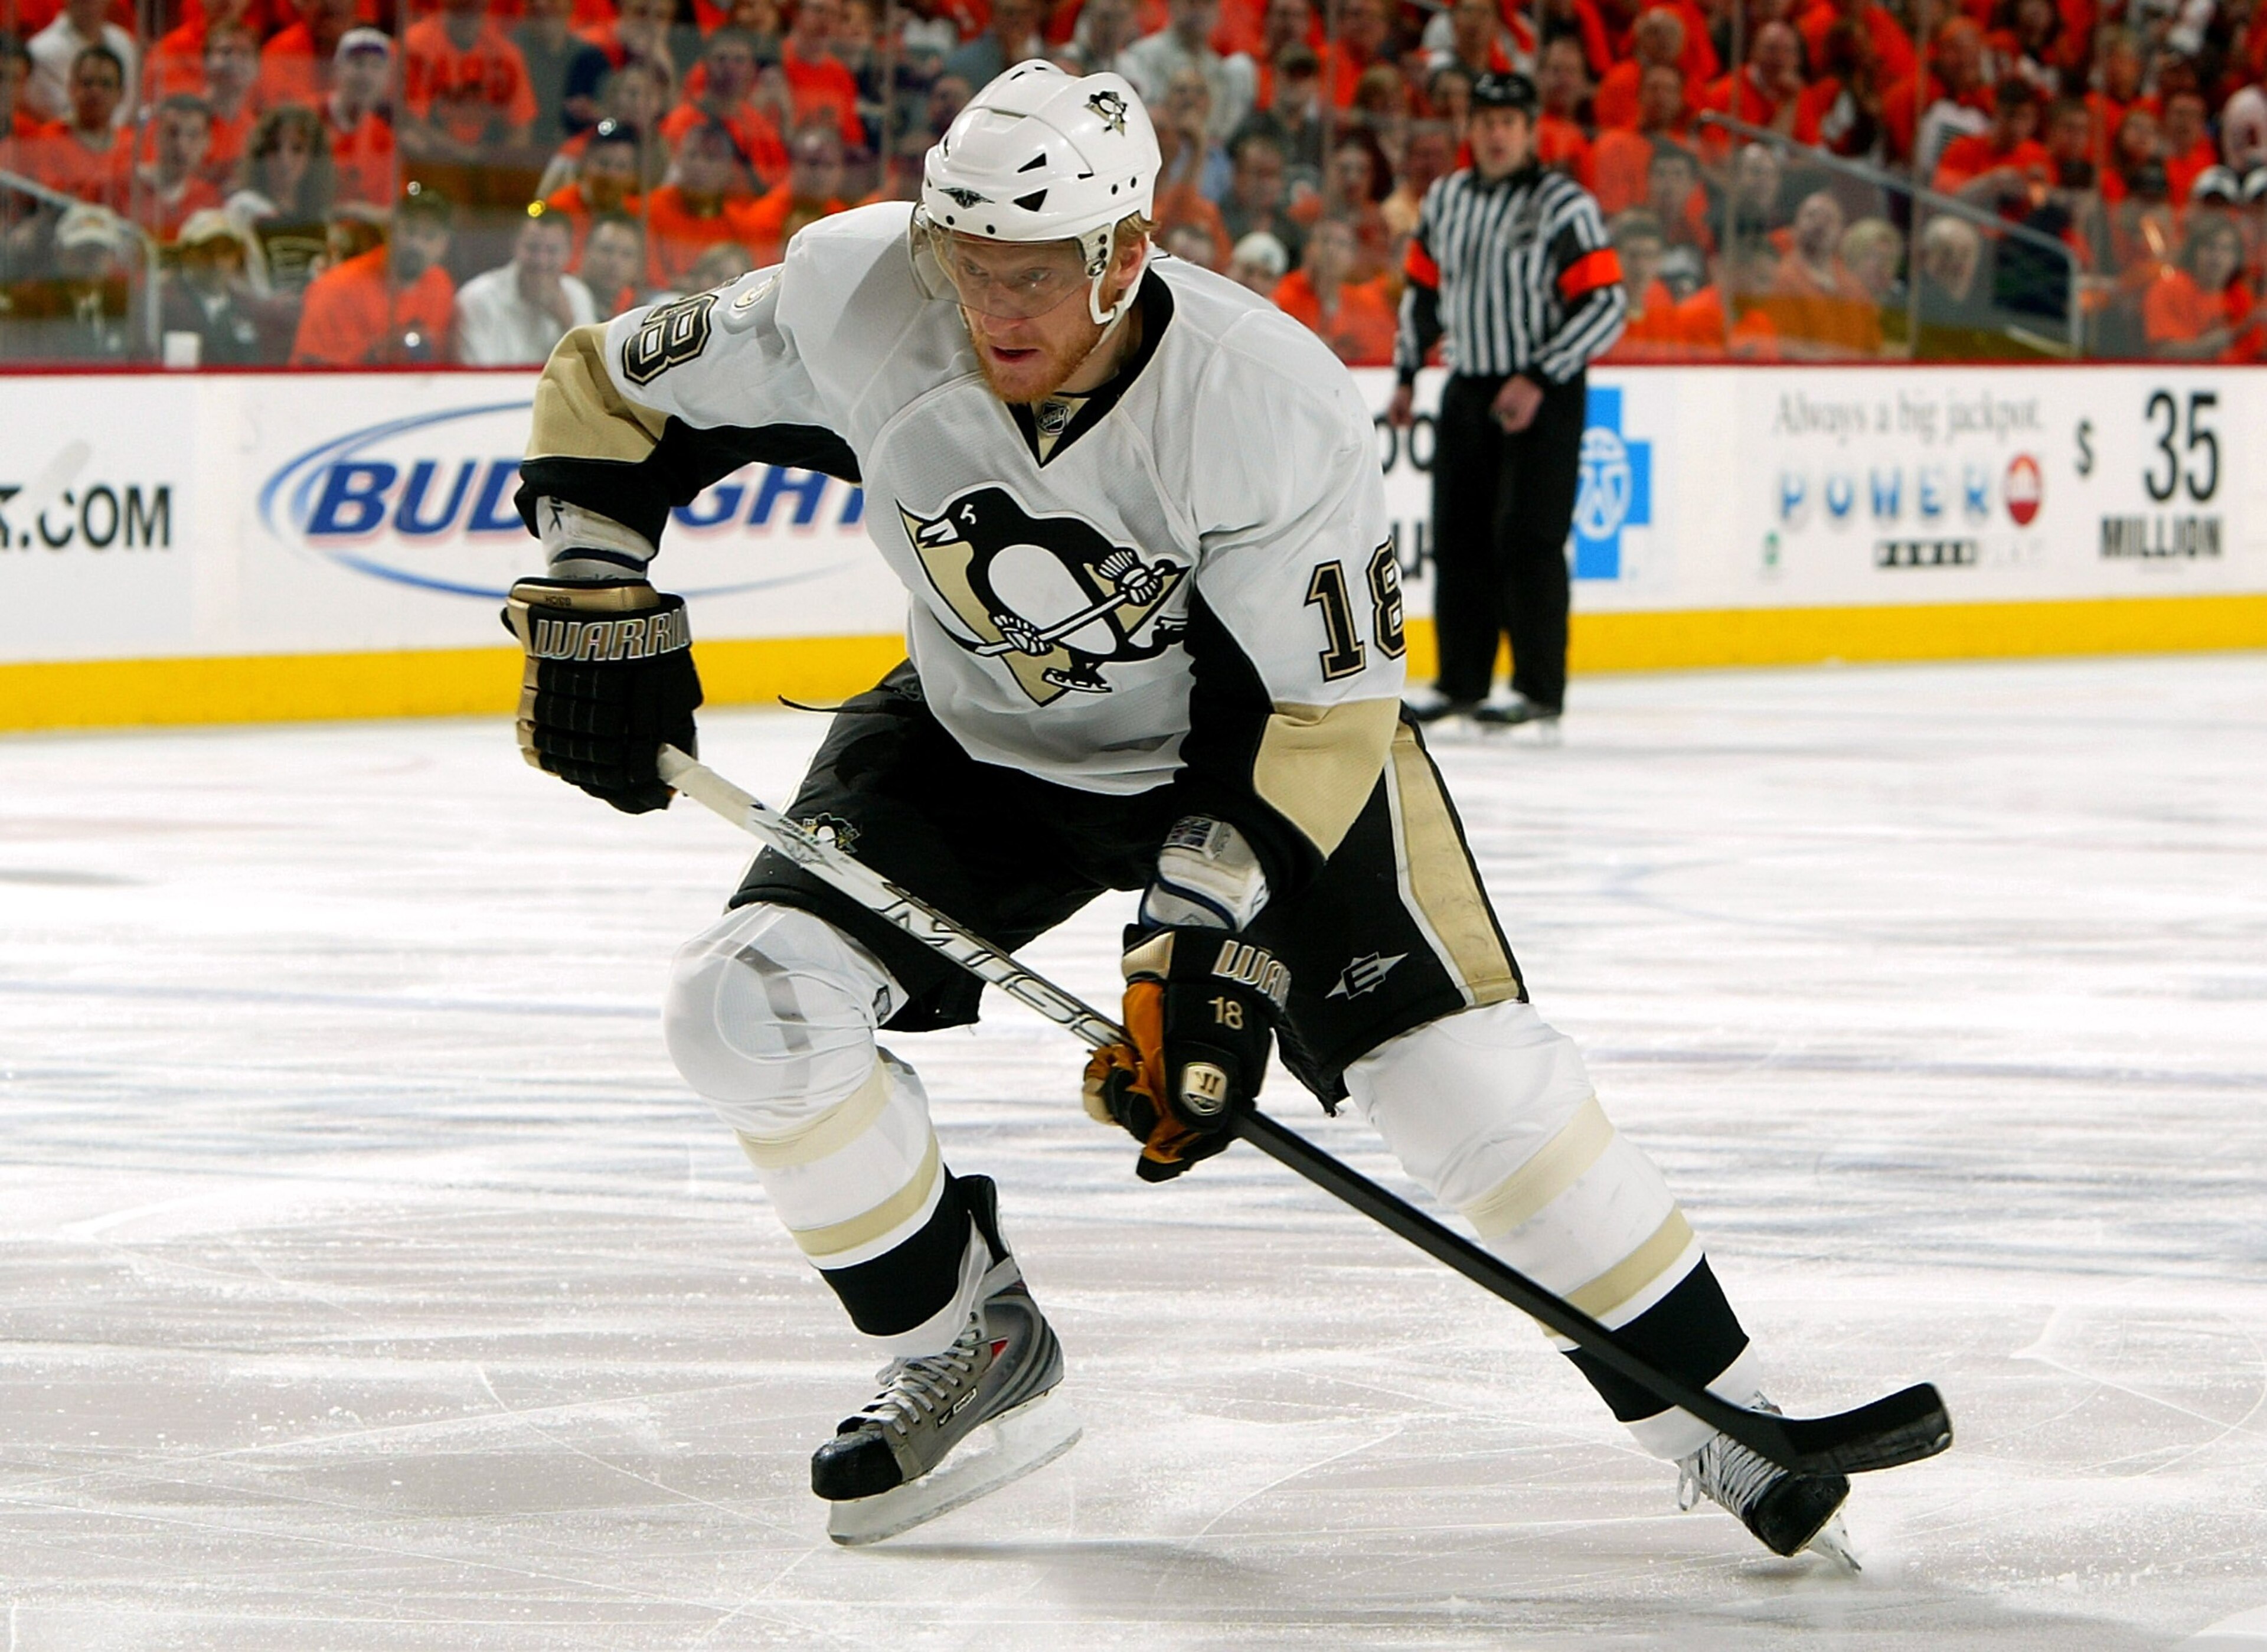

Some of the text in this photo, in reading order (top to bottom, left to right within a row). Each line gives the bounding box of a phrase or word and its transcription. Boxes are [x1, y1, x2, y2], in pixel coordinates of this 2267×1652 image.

[2145, 388, 2220, 502] 35
[308, 460, 525, 536] BUD
[1778, 462, 1991, 520] POWER
[2099, 515, 2222, 558] MILLION
[533, 607, 691, 662] WARRI
[1304, 535, 1407, 683] 18
[1211, 939, 1292, 1012] WA
[1207, 995, 1244, 1030] 18
